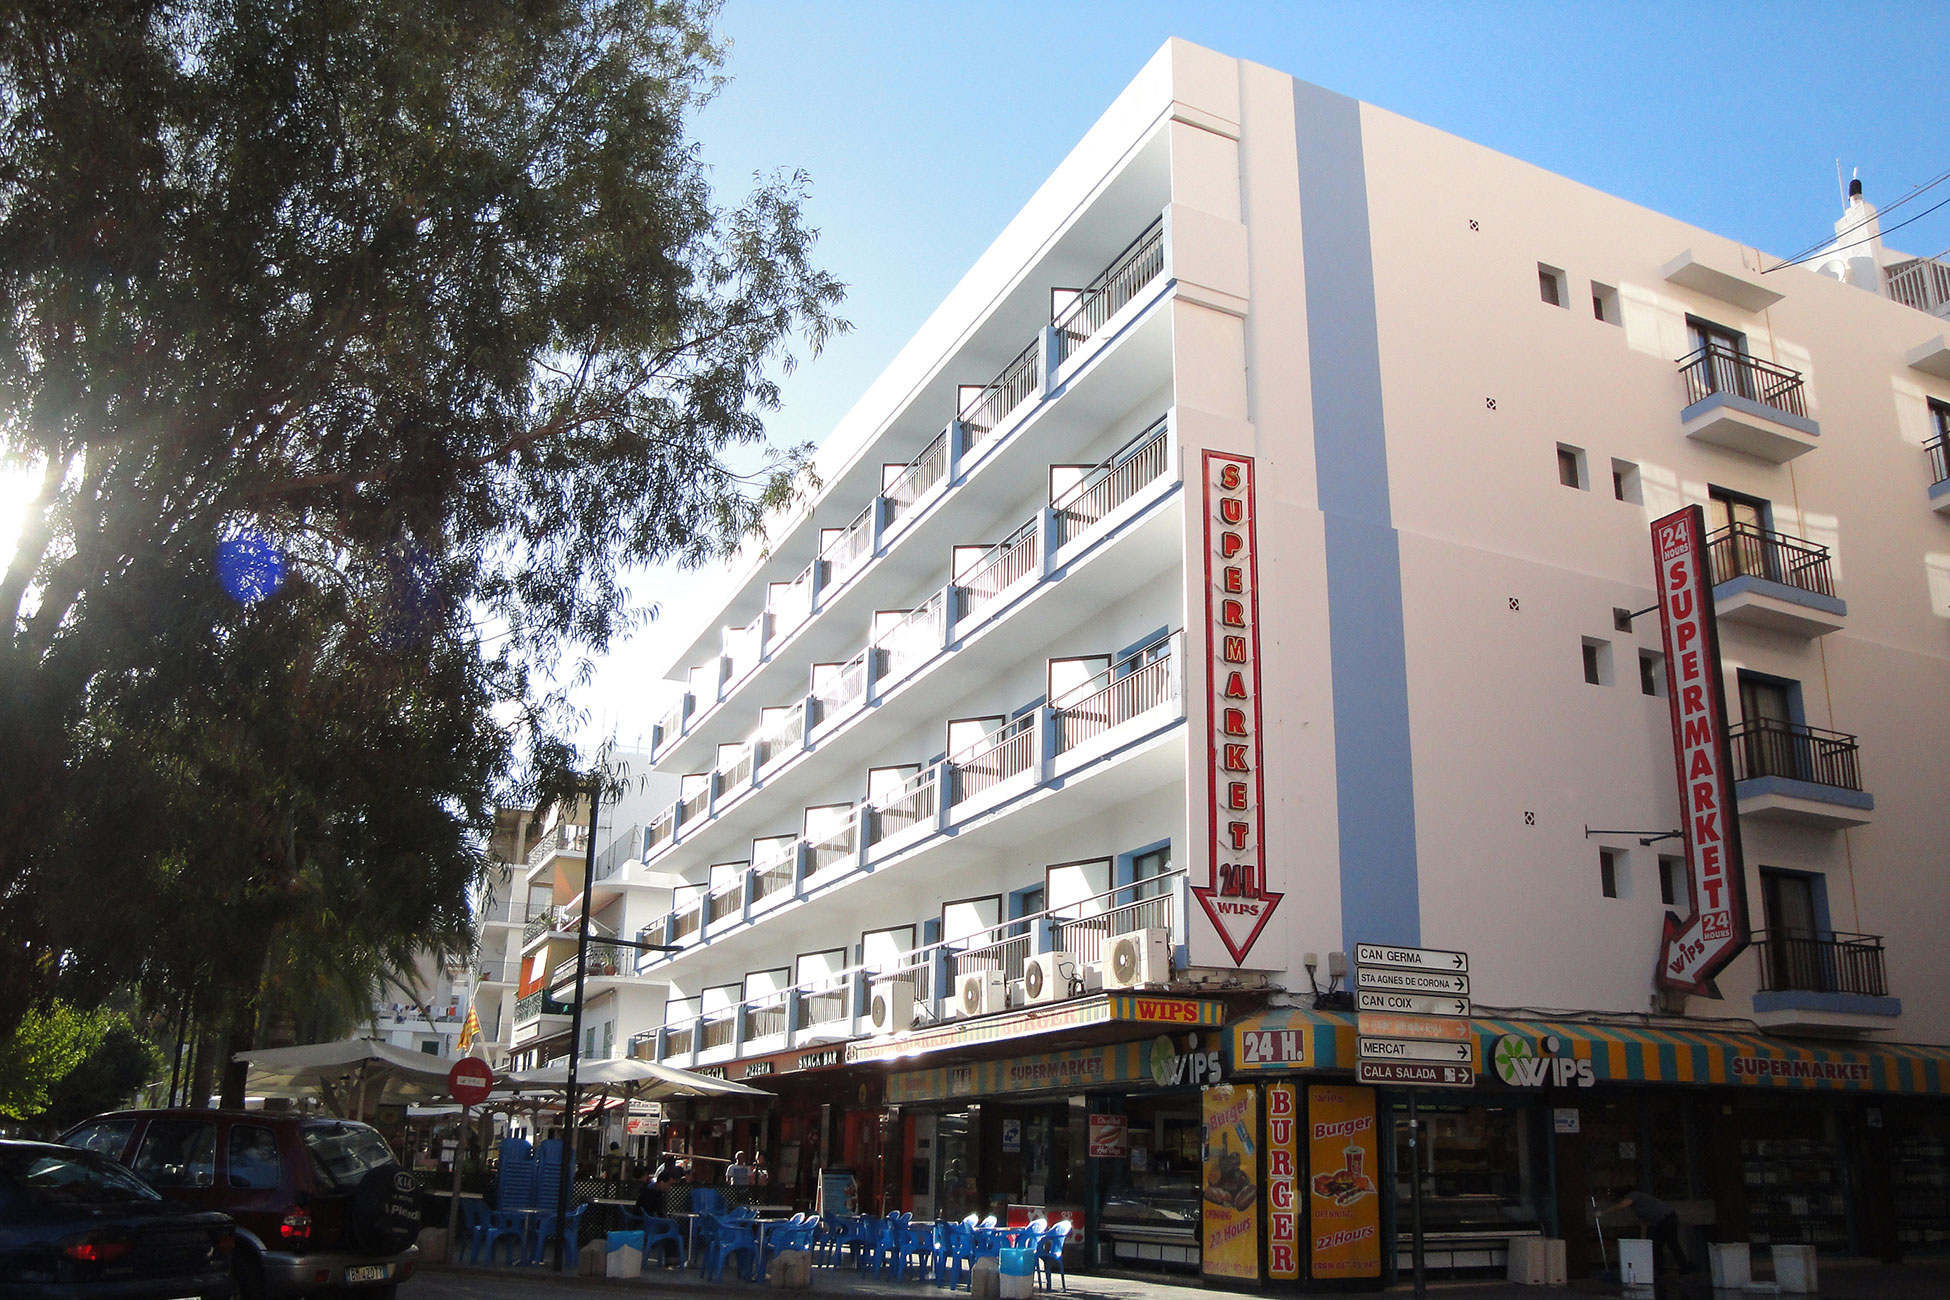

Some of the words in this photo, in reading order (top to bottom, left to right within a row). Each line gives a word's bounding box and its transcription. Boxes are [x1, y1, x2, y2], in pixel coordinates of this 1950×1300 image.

[1662, 522, 1687, 549] 24
[1664, 542, 1689, 560] HOURS
[1220, 463, 1249, 851] SUPERMARKET
[1670, 561, 1722, 909] SUPERMARKET
[1703, 912, 1729, 932] 24
[1704, 929, 1729, 940] HOURS
[1361, 948, 1383, 960] CAN
[1386, 951, 1422, 963] GERMA
[1361, 974, 1376, 983] STA
[1377, 975, 1403, 985] AGNES
[1405, 977, 1416, 986] DE
[1417, 978, 1450, 989] CORONA
[1137, 1000, 1198, 1022] WIPS
[1361, 995, 1384, 1006] CAN
[1388, 997, 1412, 1009] COIX
[1245, 1032, 1273, 1062] 24
[1363, 1042, 1405, 1055] MERCAT
[745, 1061, 774, 1077] PIZZERIA
[798, 1055, 821, 1069] SNACK
[823, 1049, 838, 1066] BAR
[1009, 1056, 1103, 1082] SUPERMARKET
[1732, 1057, 1870, 1080] SUPERMARKET
[1363, 1066, 1393, 1078] CALA
[1395, 1069, 1437, 1080] SALADA
[1209, 1097, 1249, 1131] Burger
[1314, 1116, 1373, 1139] Burger
[1270, 1090, 1295, 1273] BURGER
[1223, 1217, 1251, 1241] Hours
[1334, 1226, 1374, 1244] Hours
